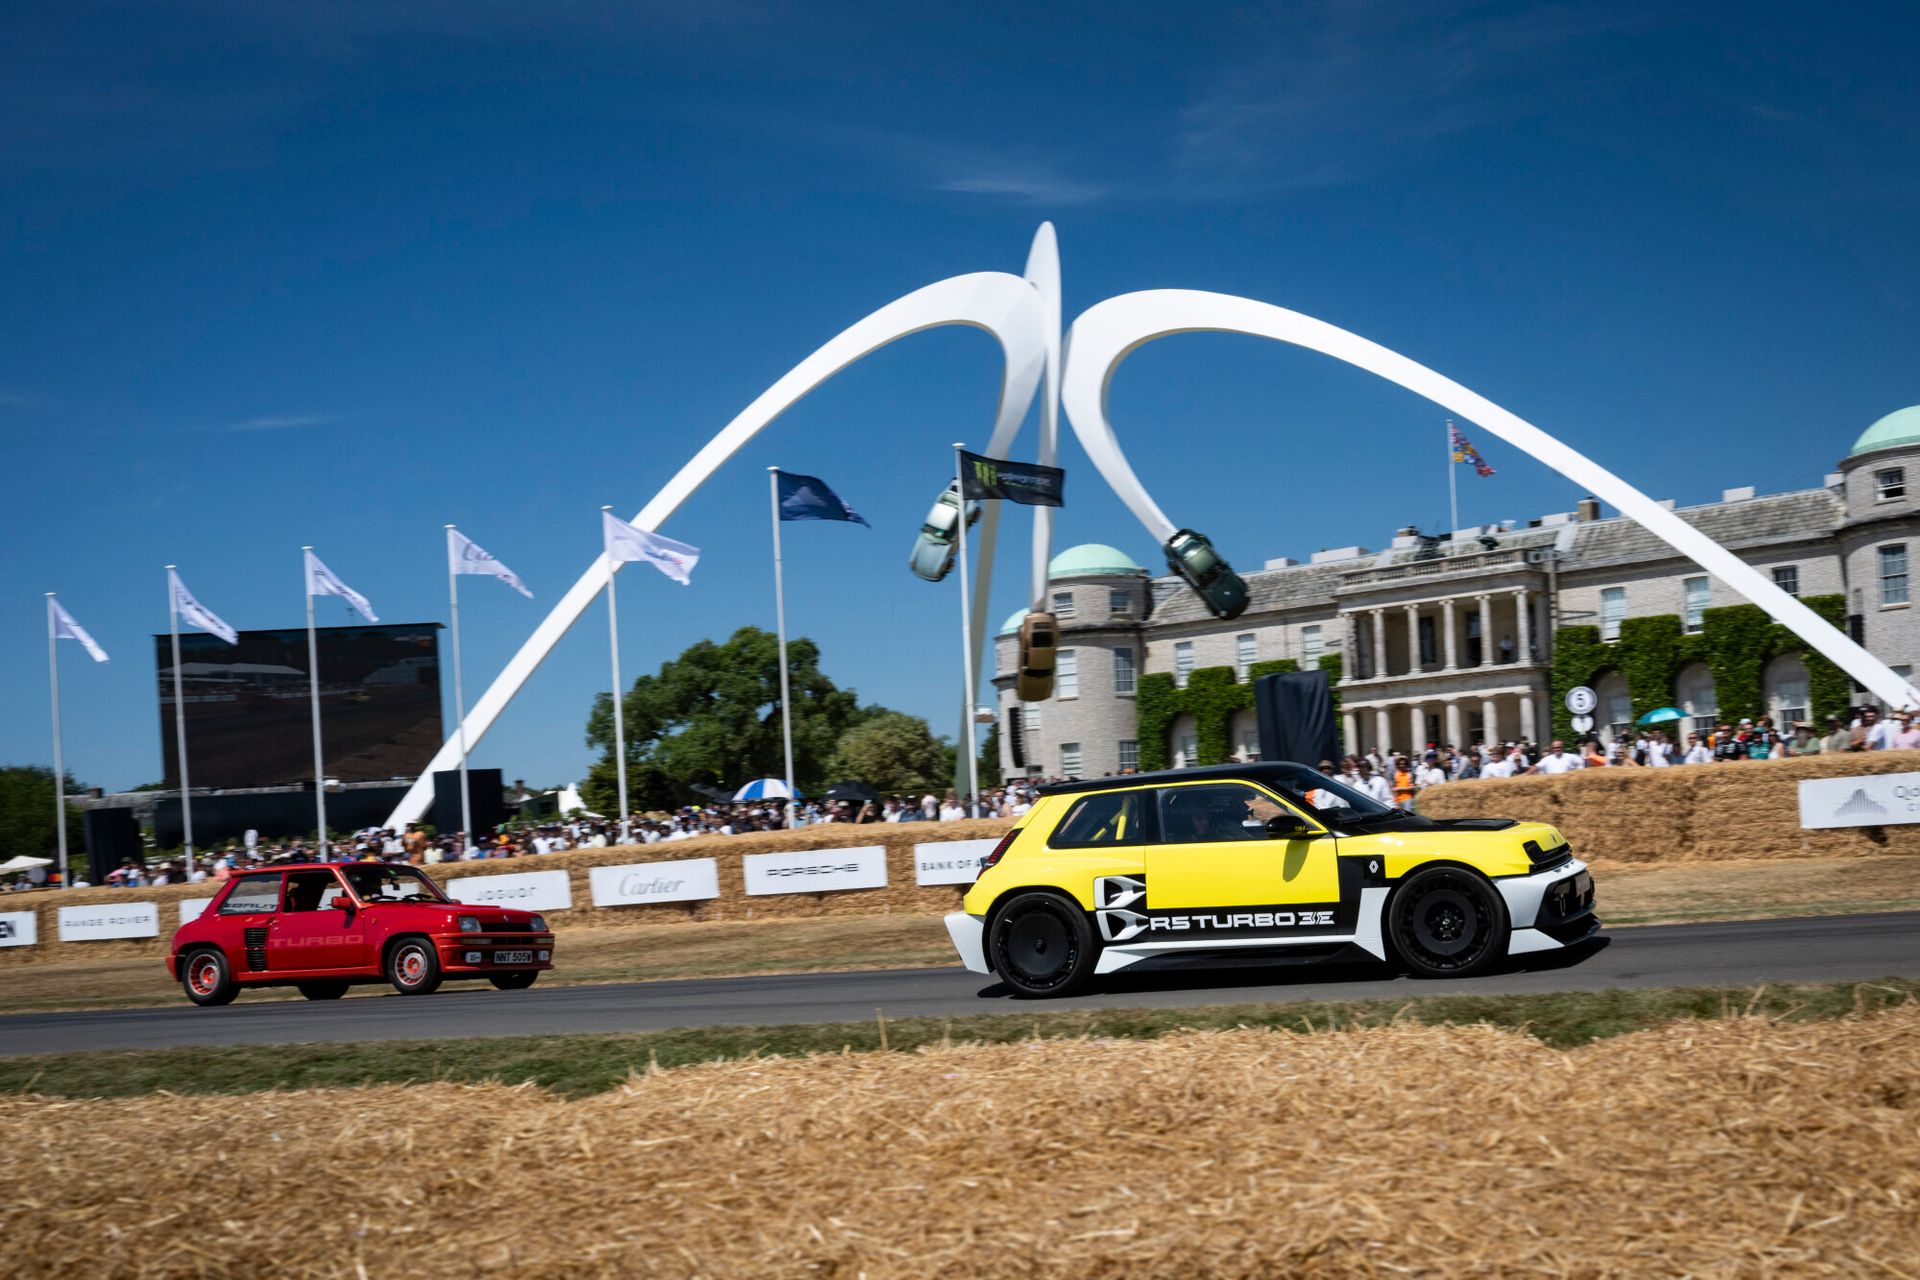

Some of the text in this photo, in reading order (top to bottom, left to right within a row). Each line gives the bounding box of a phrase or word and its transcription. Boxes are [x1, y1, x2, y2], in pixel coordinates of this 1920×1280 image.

[766, 863, 859, 877] PORSCHE
[921, 861, 953, 871] BANK
[956, 859, 972, 869] OF
[619, 872, 685, 897] Cartier
[108, 915, 150, 925] ROVER
[1151, 916, 1190, 931] R5
[1192, 912, 1296, 929] TURBO
[270, 934, 364, 948] TURBO
[496, 952, 511, 962] NNT
